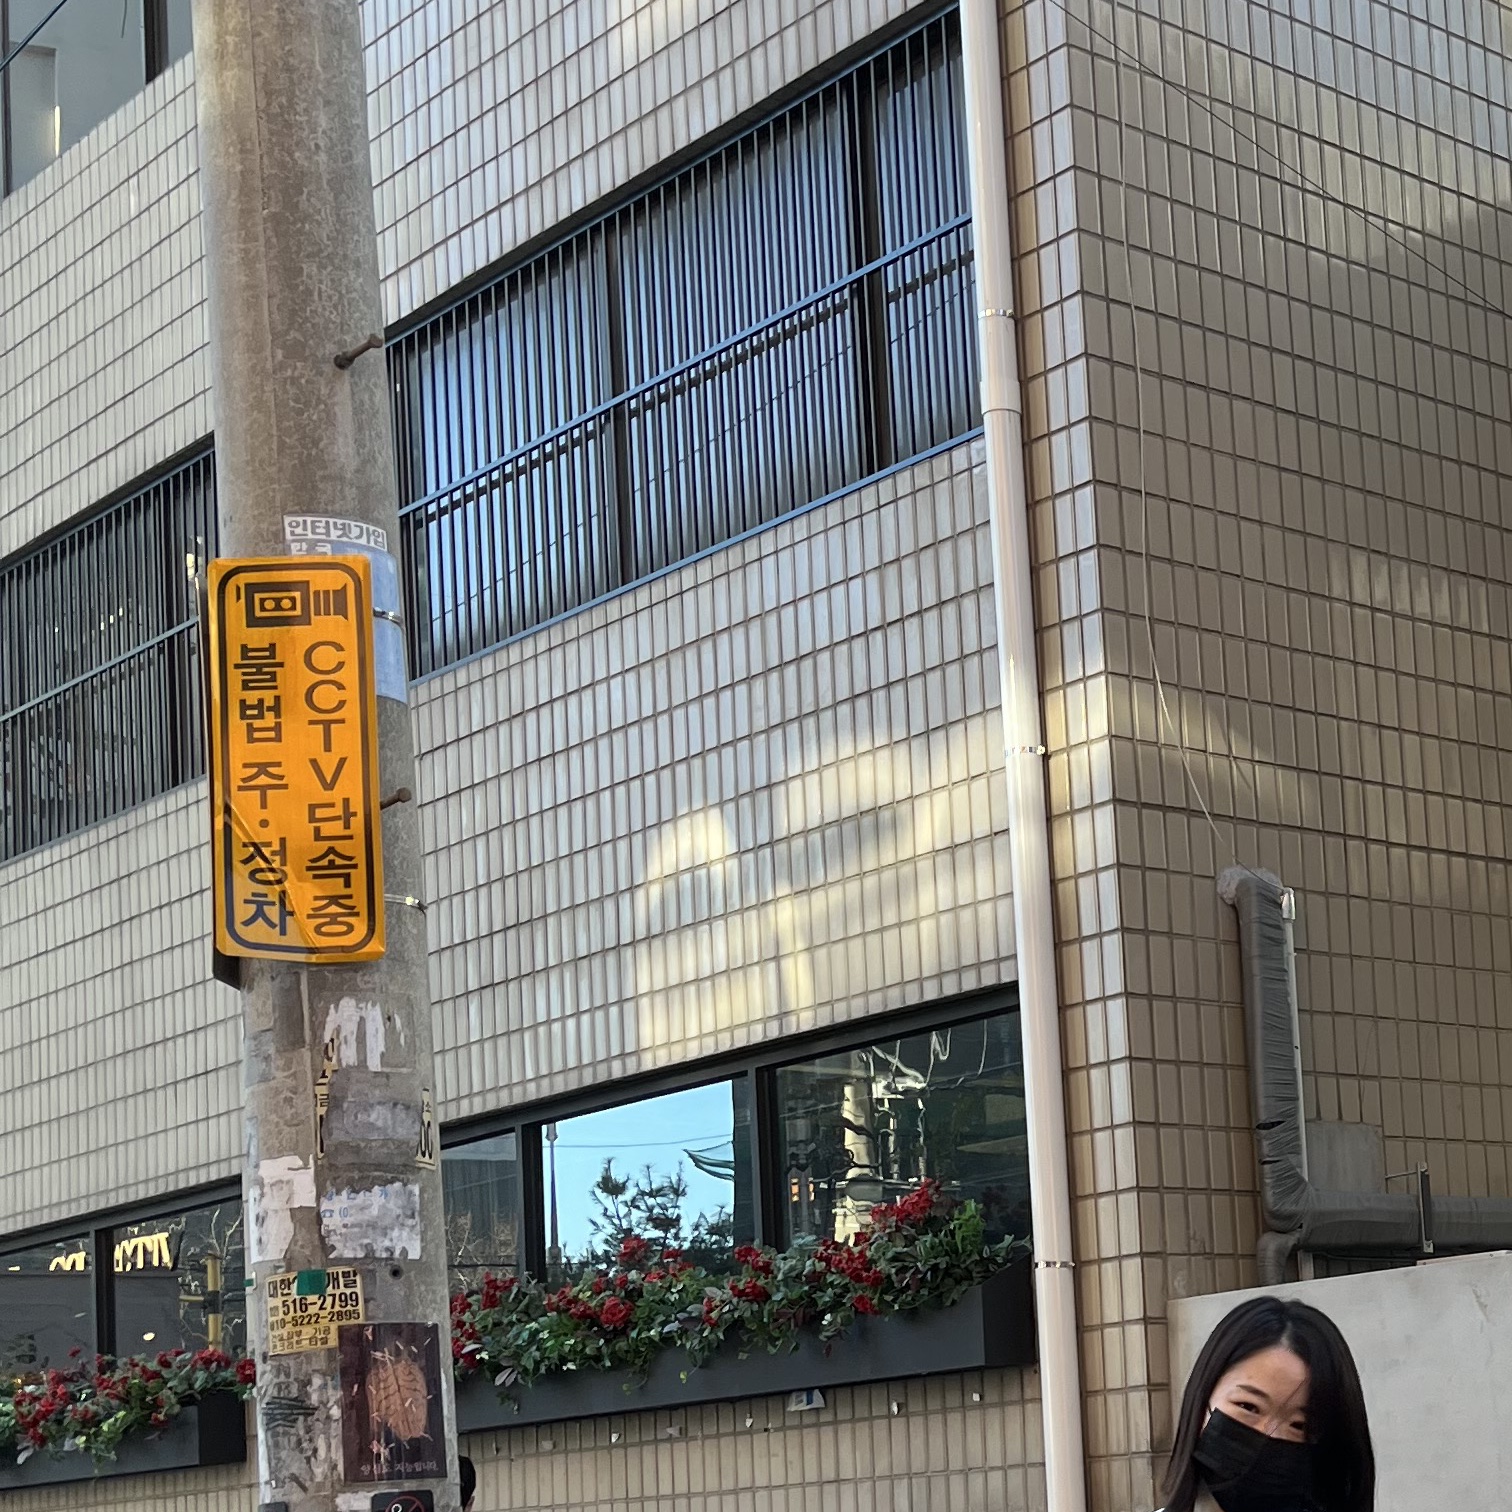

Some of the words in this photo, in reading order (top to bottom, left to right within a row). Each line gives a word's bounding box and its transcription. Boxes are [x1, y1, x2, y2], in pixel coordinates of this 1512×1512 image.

[288, 519, 386, 549] 인터넷가입
[233, 642, 285, 745] 불법
[282, 1291, 359, 1316] 516-2799
